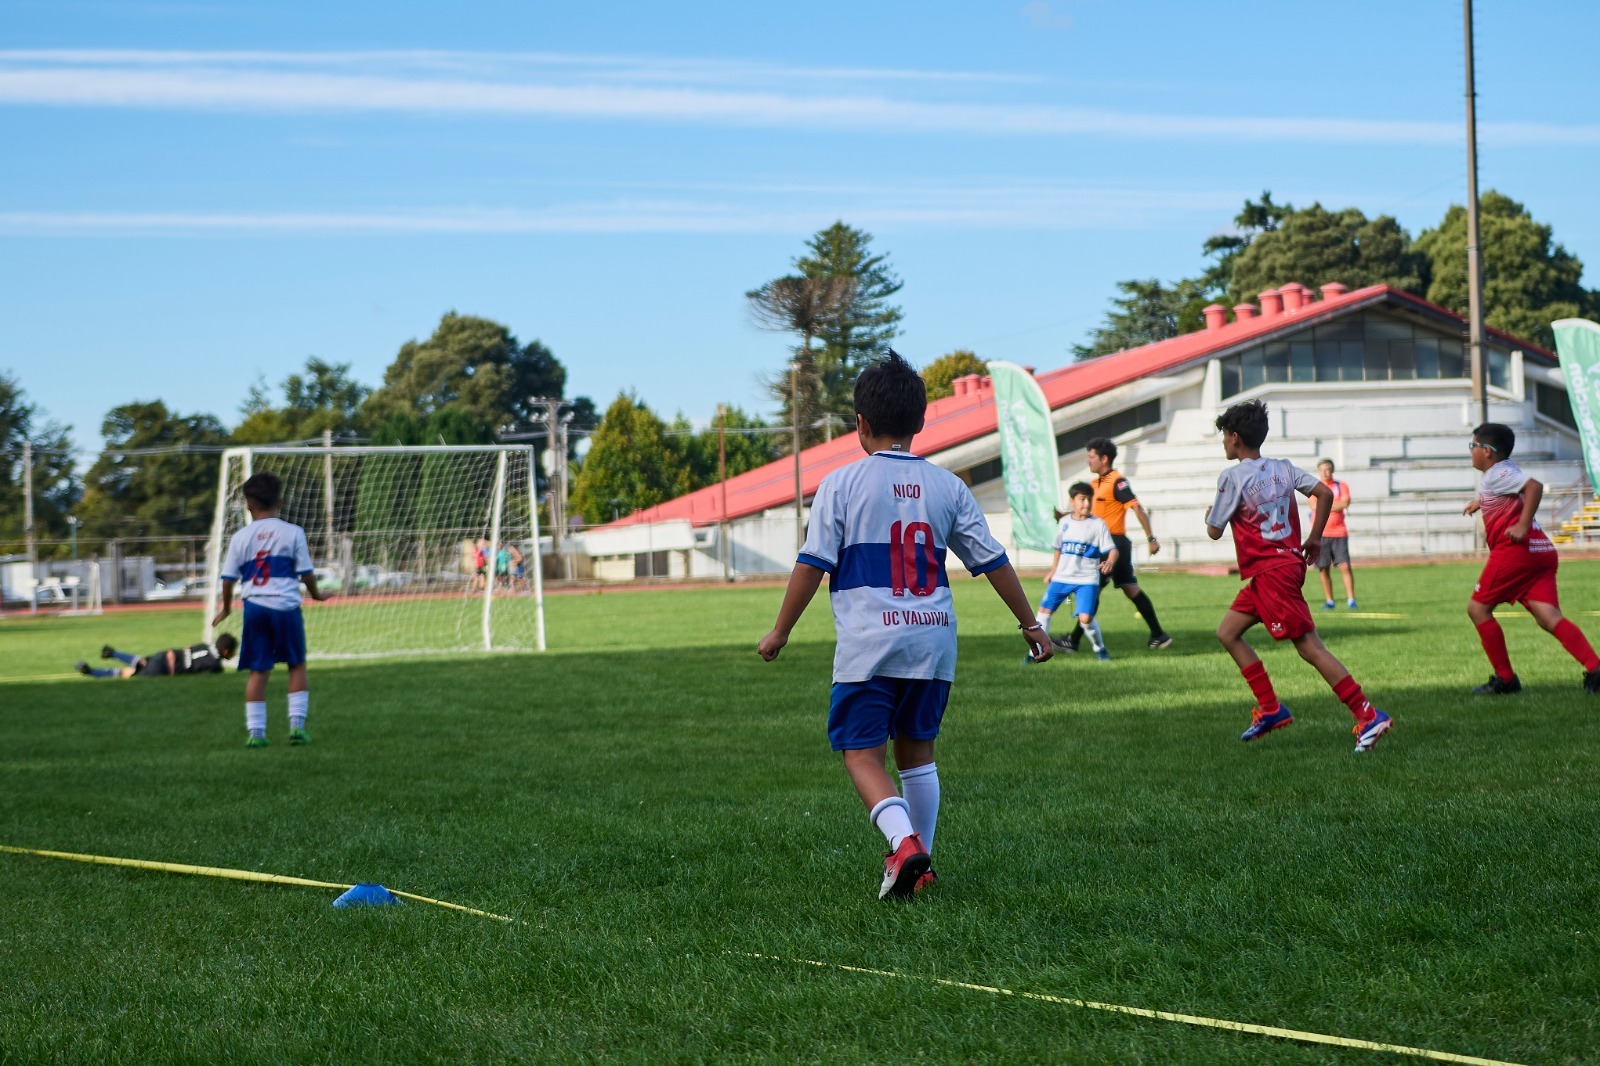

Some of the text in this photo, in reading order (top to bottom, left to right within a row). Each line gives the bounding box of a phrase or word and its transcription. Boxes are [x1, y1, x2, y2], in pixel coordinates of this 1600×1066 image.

[893, 483, 921, 499] NICO
[890, 520, 938, 597] 10
[882, 610, 949, 627] UC VALDIVIA
